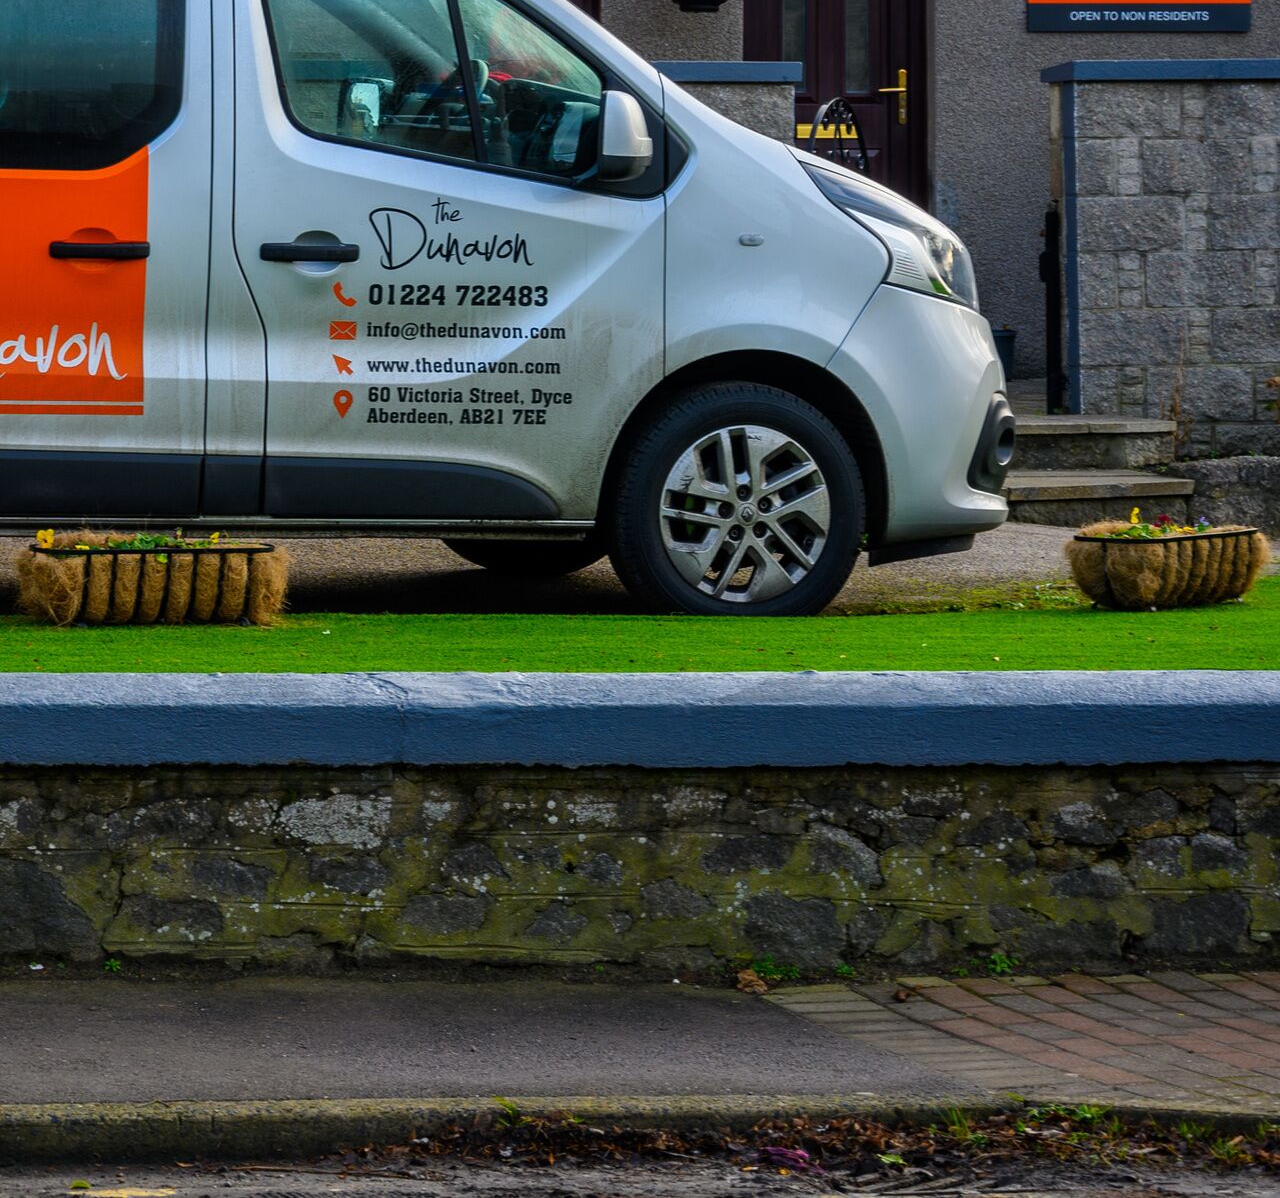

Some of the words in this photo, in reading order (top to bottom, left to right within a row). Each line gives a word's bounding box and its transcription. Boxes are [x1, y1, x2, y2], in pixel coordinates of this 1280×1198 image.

[1070, 10, 1100, 21] OPEN
[1103, 11, 1119, 21] TO
[1121, 11, 1146, 21] NON
[1148, 11, 1210, 21] RESIDENTS
[368, 207, 535, 271] Dunavon
[368, 283, 446, 306] 01224
[456, 284, 549, 307] 722483
[366, 322, 566, 341] info@thedunavon.com
[366, 357, 561, 375] www.thedunavon.com
[368, 386, 391, 403] 60
[397, 387, 464, 404] Victoria
[469, 388, 525, 407] Street,
[531, 388, 573, 408] Dyce
[366, 408, 454, 427] Aberdeen,
[460, 409, 505, 425] AB21
[512, 409, 547, 426] 7EE
